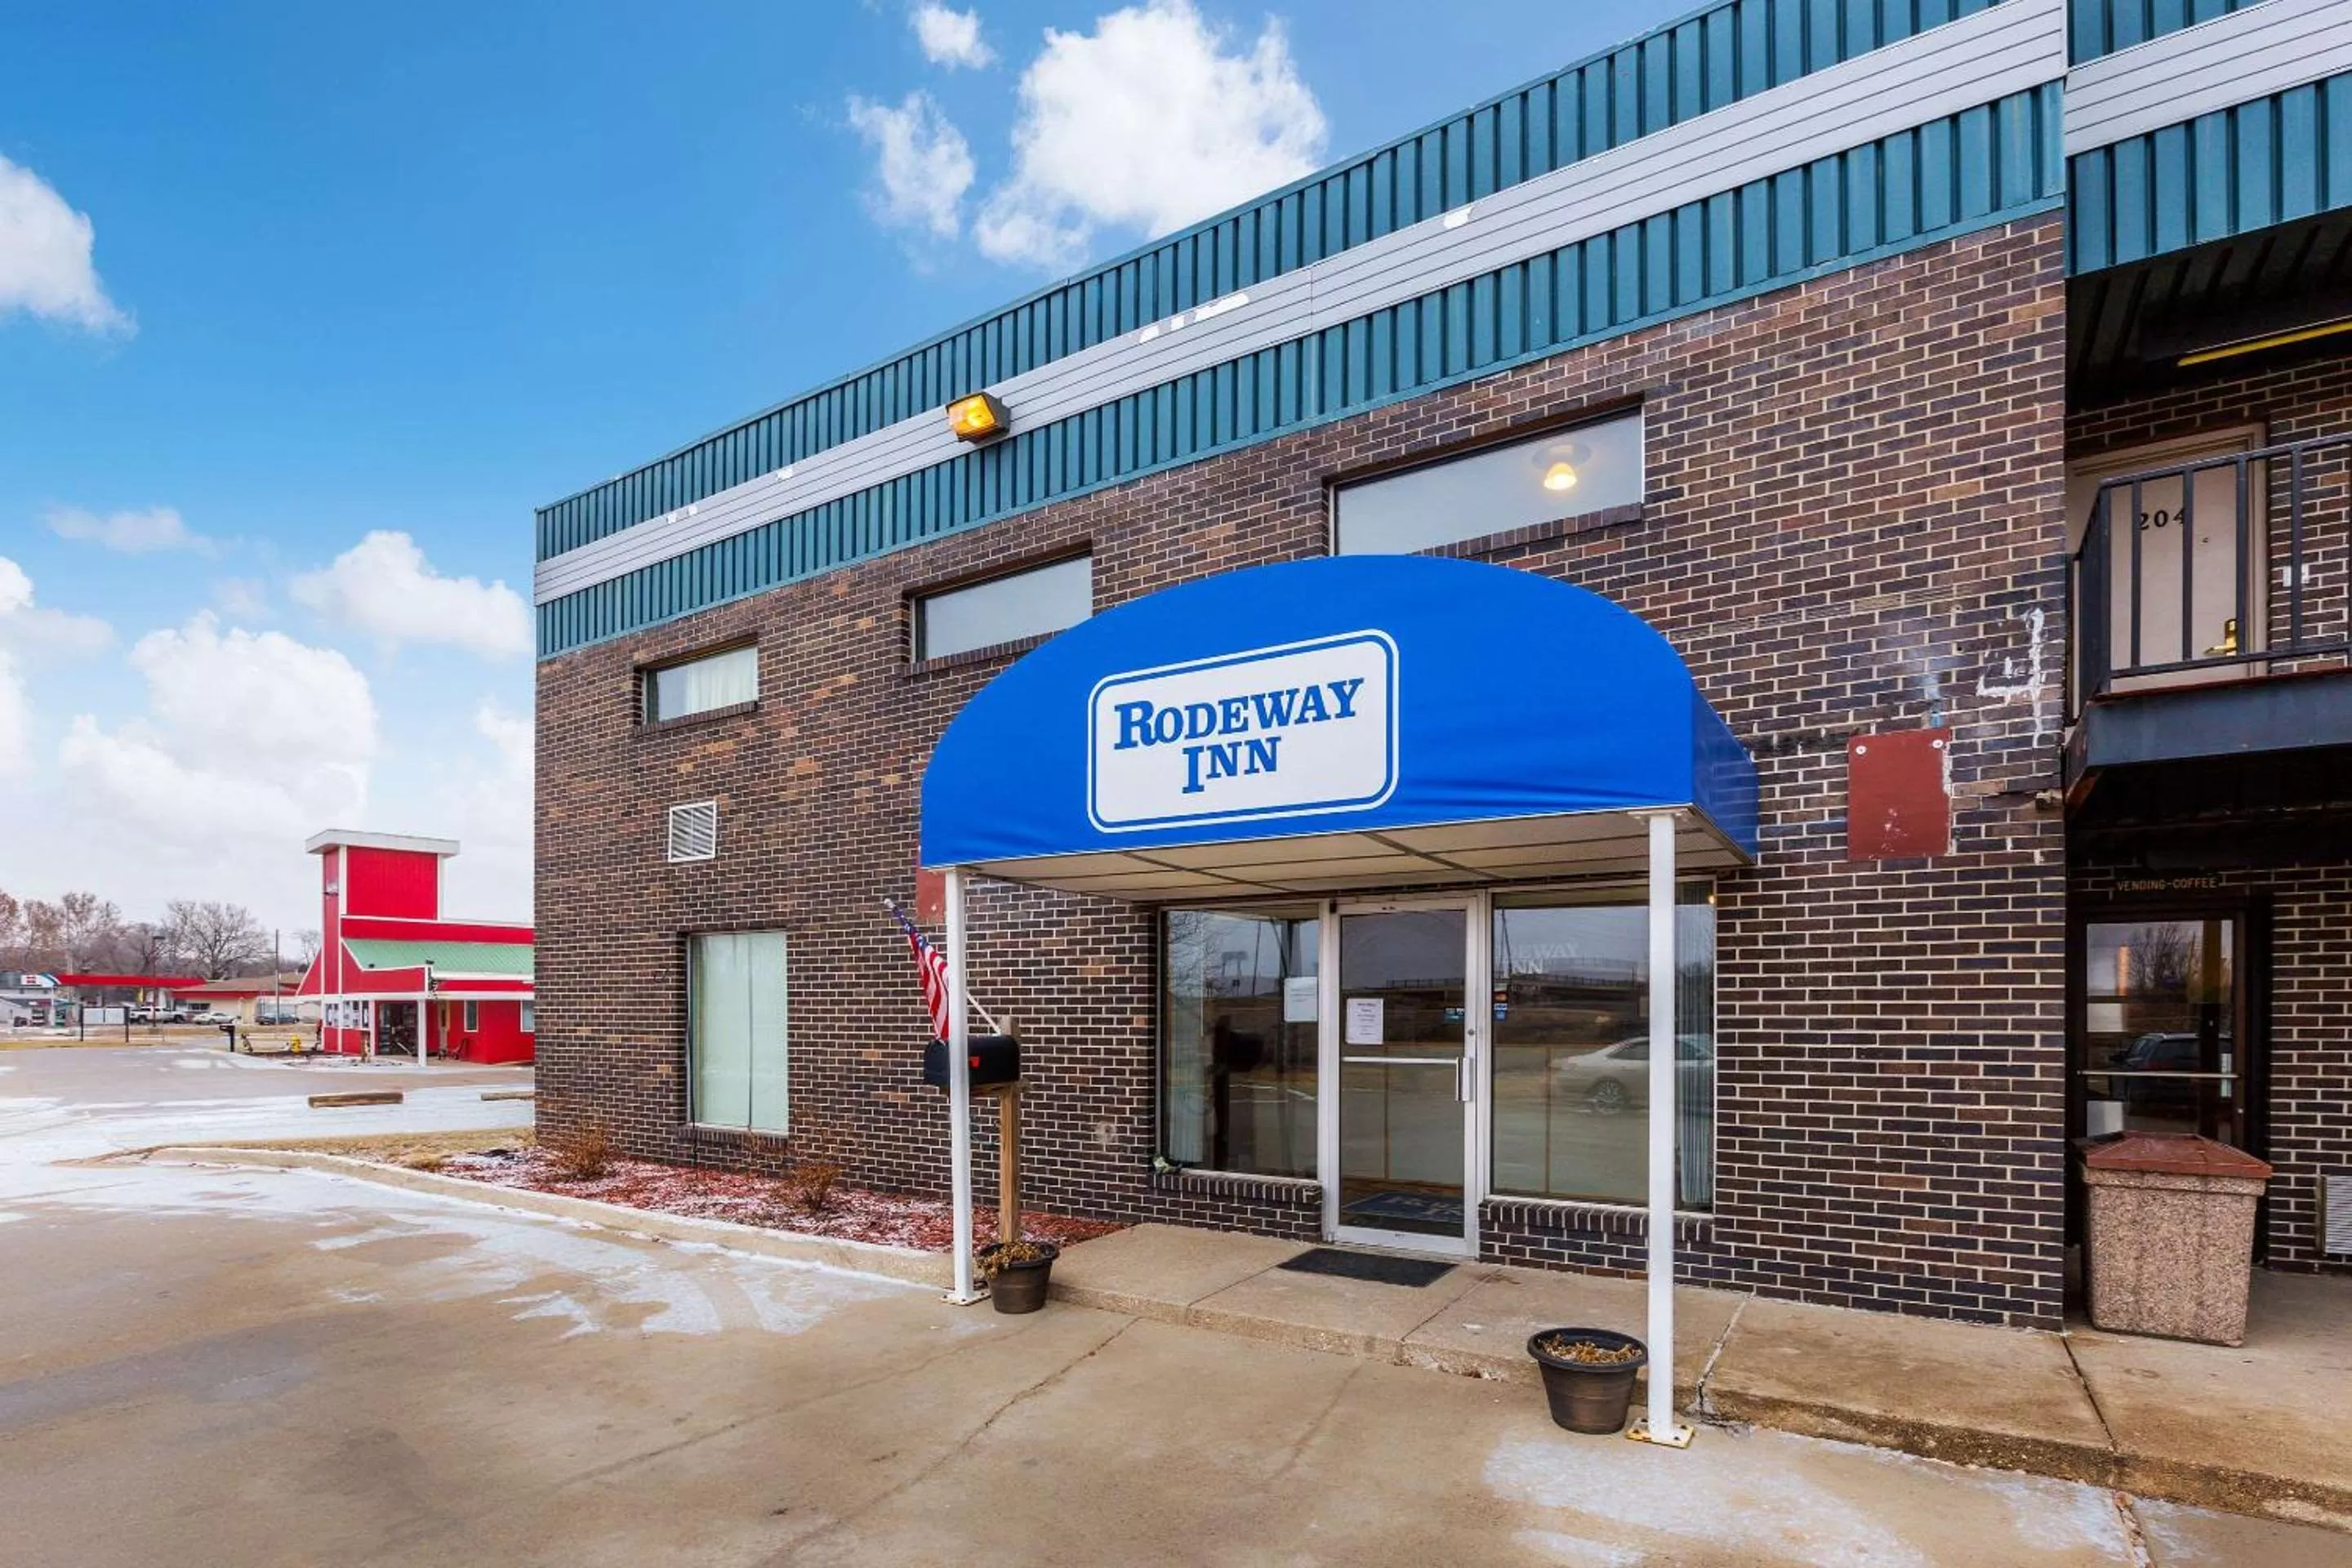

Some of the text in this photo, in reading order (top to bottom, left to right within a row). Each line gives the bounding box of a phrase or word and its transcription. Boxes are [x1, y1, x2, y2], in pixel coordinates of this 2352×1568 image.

[2139, 507, 2185, 530] 204
[1114, 678, 1365, 751] RODEWAY
[1182, 737, 1281, 794] INN
